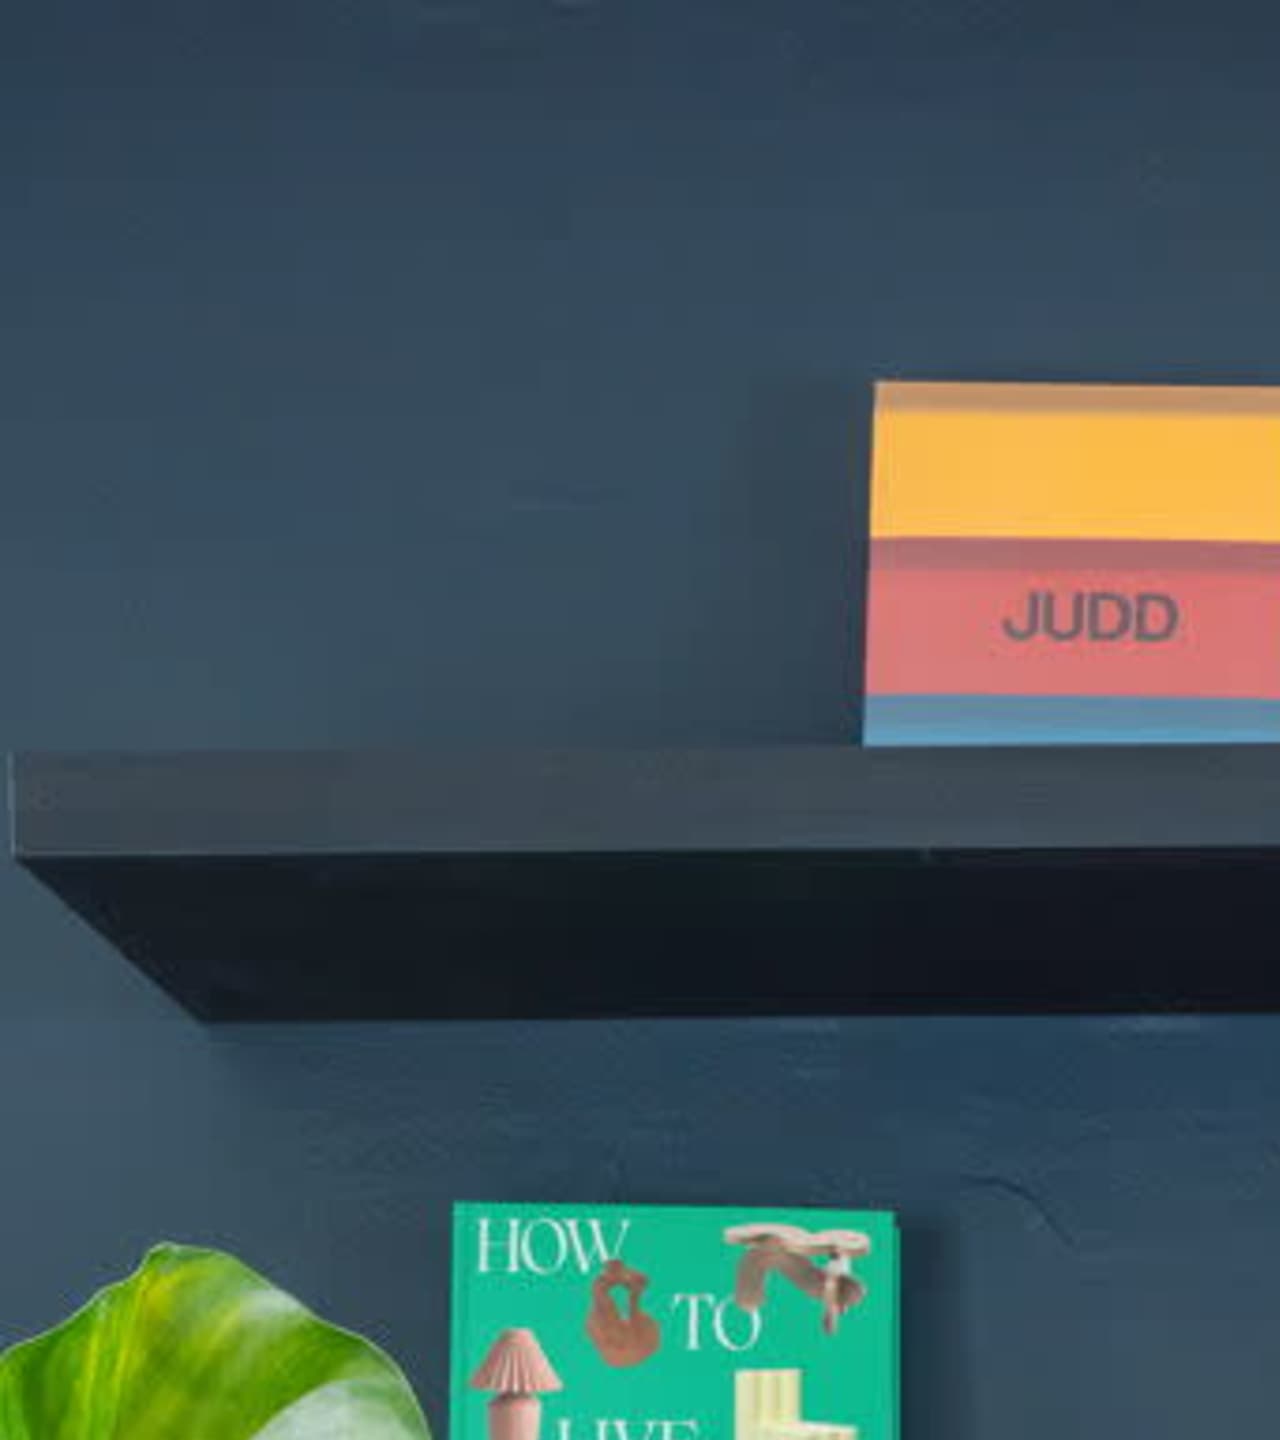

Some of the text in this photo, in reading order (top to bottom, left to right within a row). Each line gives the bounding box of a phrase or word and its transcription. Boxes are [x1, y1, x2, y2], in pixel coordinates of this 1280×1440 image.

[1002, 590, 1180, 642] JUDD
[475, 1217, 630, 1274] HOW
[670, 1293, 762, 1351] TO
